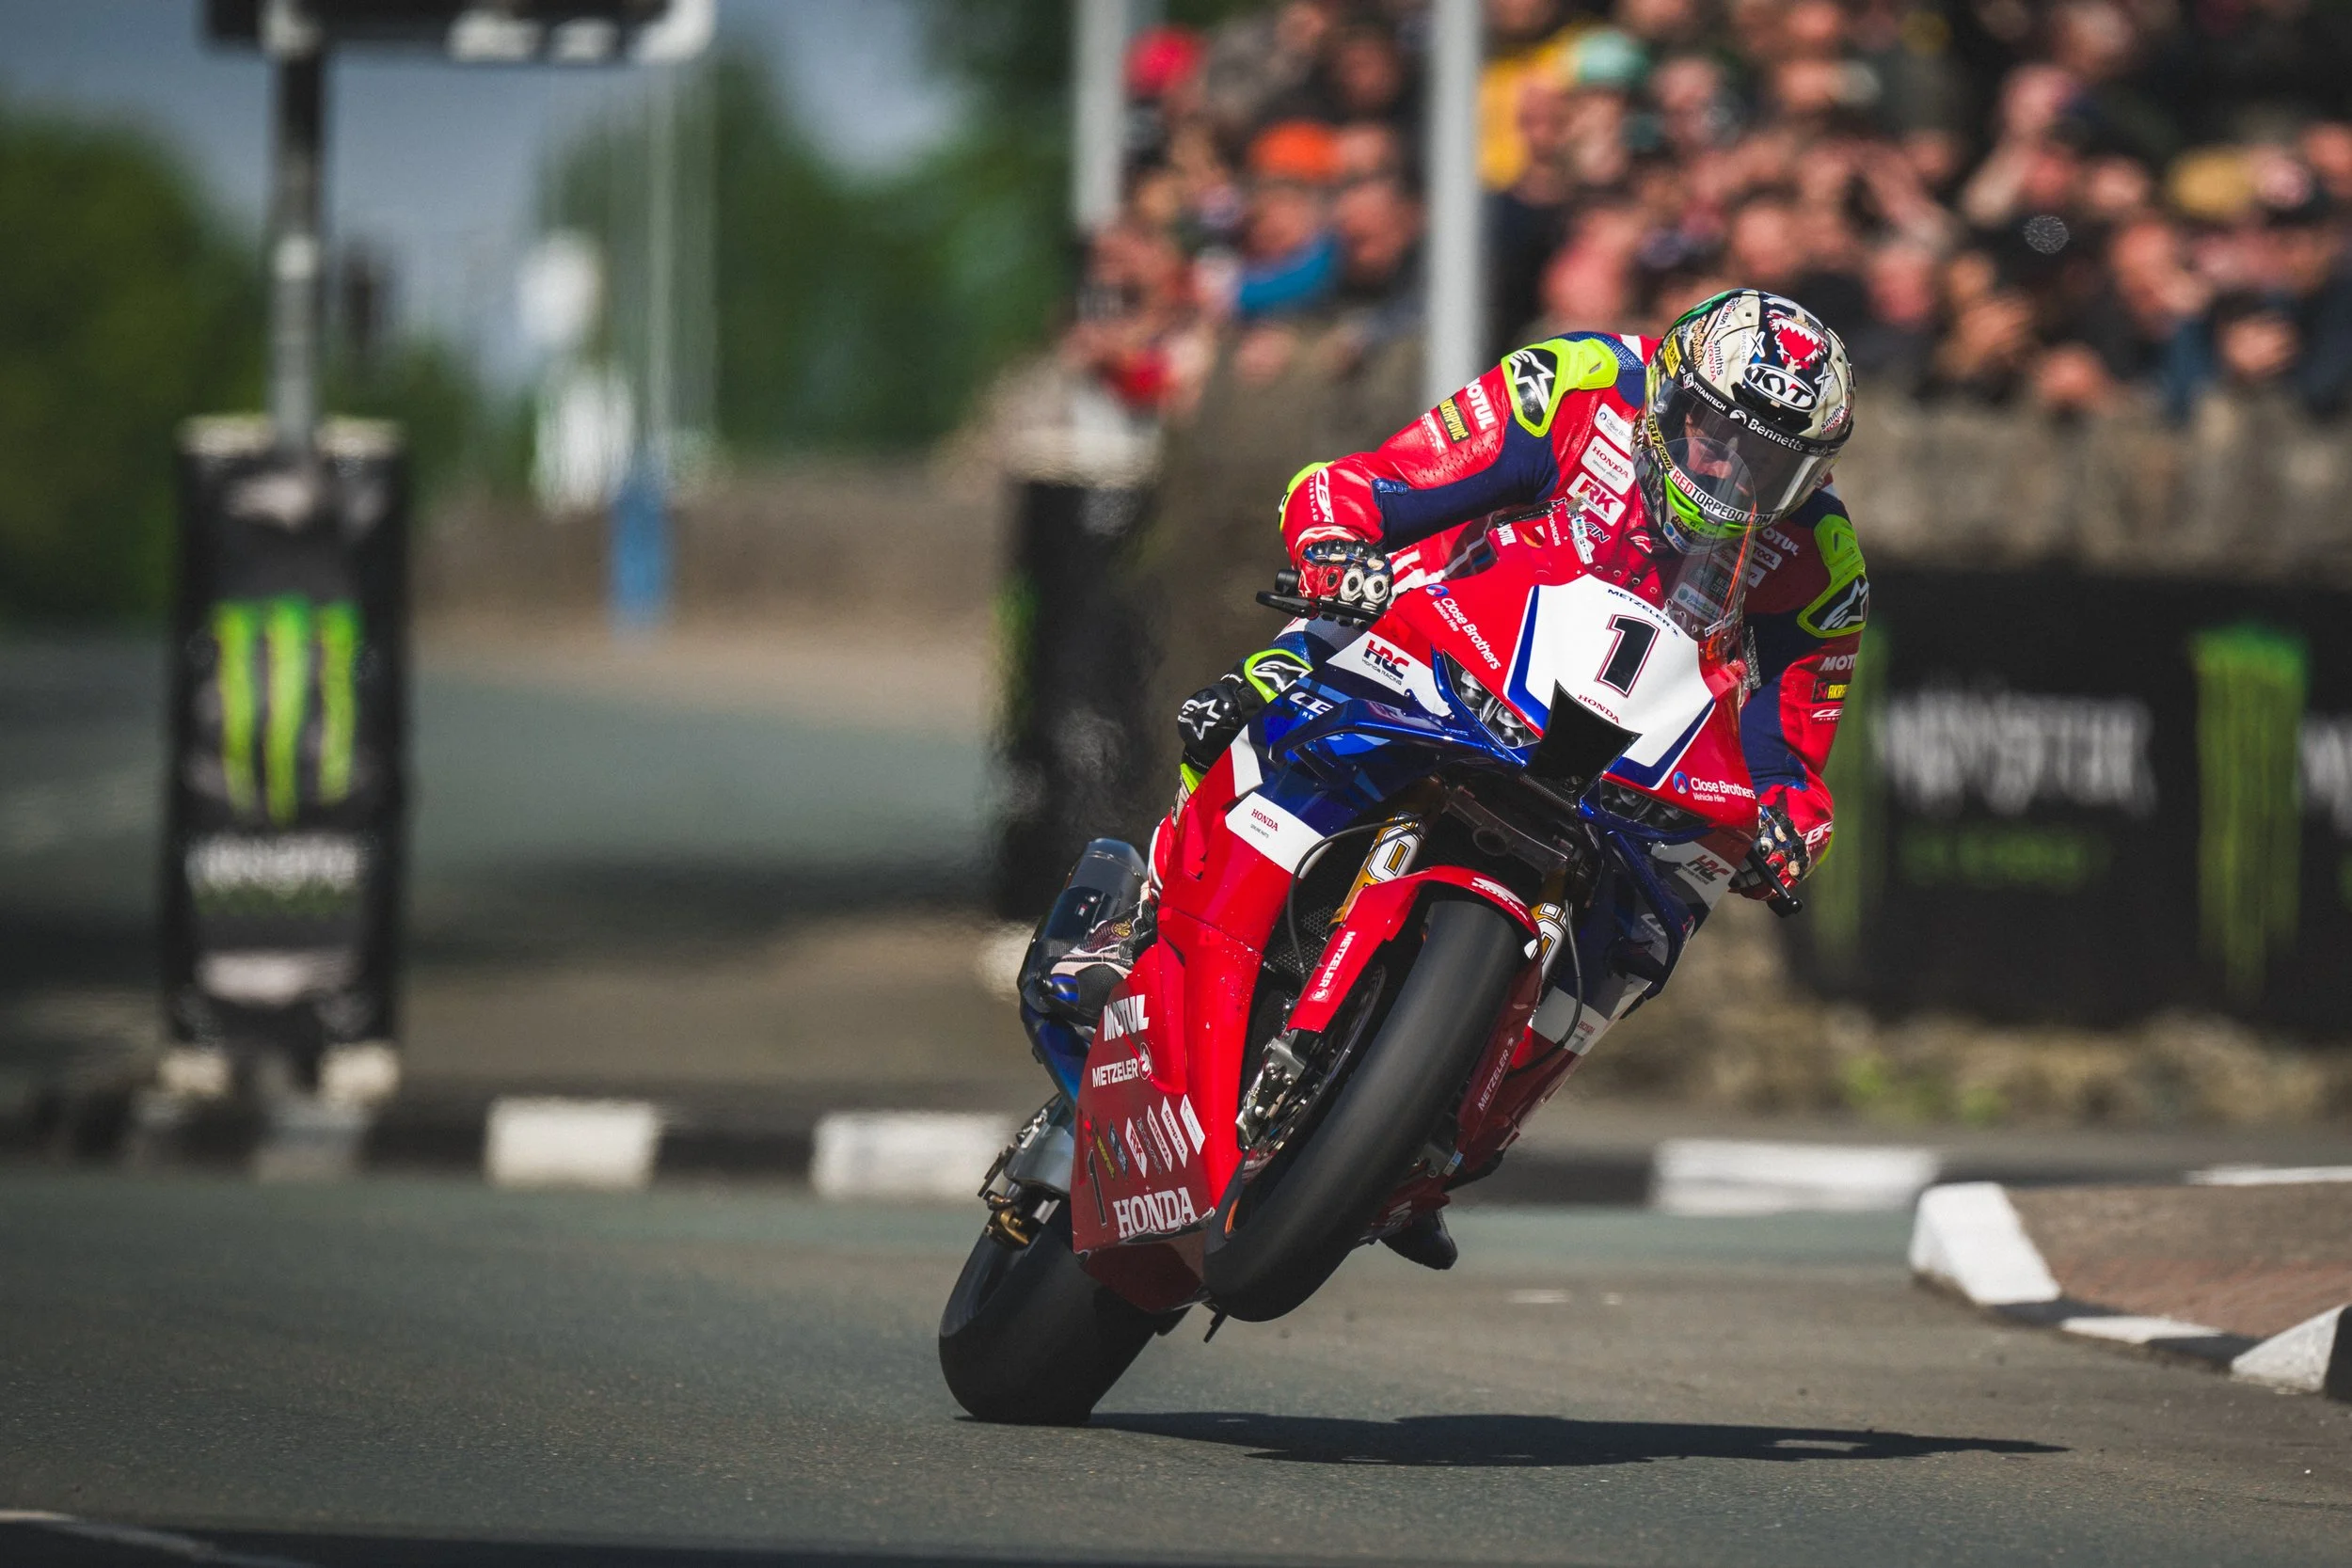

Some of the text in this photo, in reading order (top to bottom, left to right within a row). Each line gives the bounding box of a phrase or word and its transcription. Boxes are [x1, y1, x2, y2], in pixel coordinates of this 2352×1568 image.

[1713, 340, 1724, 375] smiths
[1693, 381, 1726, 411] TITANTECH
[1751, 367, 1813, 404] KYT
[1748, 418, 1804, 451] Bennetts
[1592, 445, 1629, 479] HONDA
[1577, 479, 1617, 515] RK
[1762, 527, 1800, 557] OTUL
[1608, 588, 1670, 627] METZELER
[1441, 597, 1502, 670] Close Brothers
[1363, 639, 1410, 679] HRC
[1594, 613, 1661, 699] 1
[1819, 654, 1857, 671] MOT
[1578, 694, 1619, 724] HONDA
[1691, 777, 1756, 800] Close Brothers
[1692, 792, 1726, 802] Vehicle Hire
[1251, 808, 1279, 832] HONDA
[1319, 931, 1357, 988] METZELER
[1104, 993, 1150, 1041] MOTUL
[1091, 1057, 1138, 1087] METZELER
[1478, 1049, 1510, 1111] METZELER
[1113, 1186, 1198, 1239] HONDA
